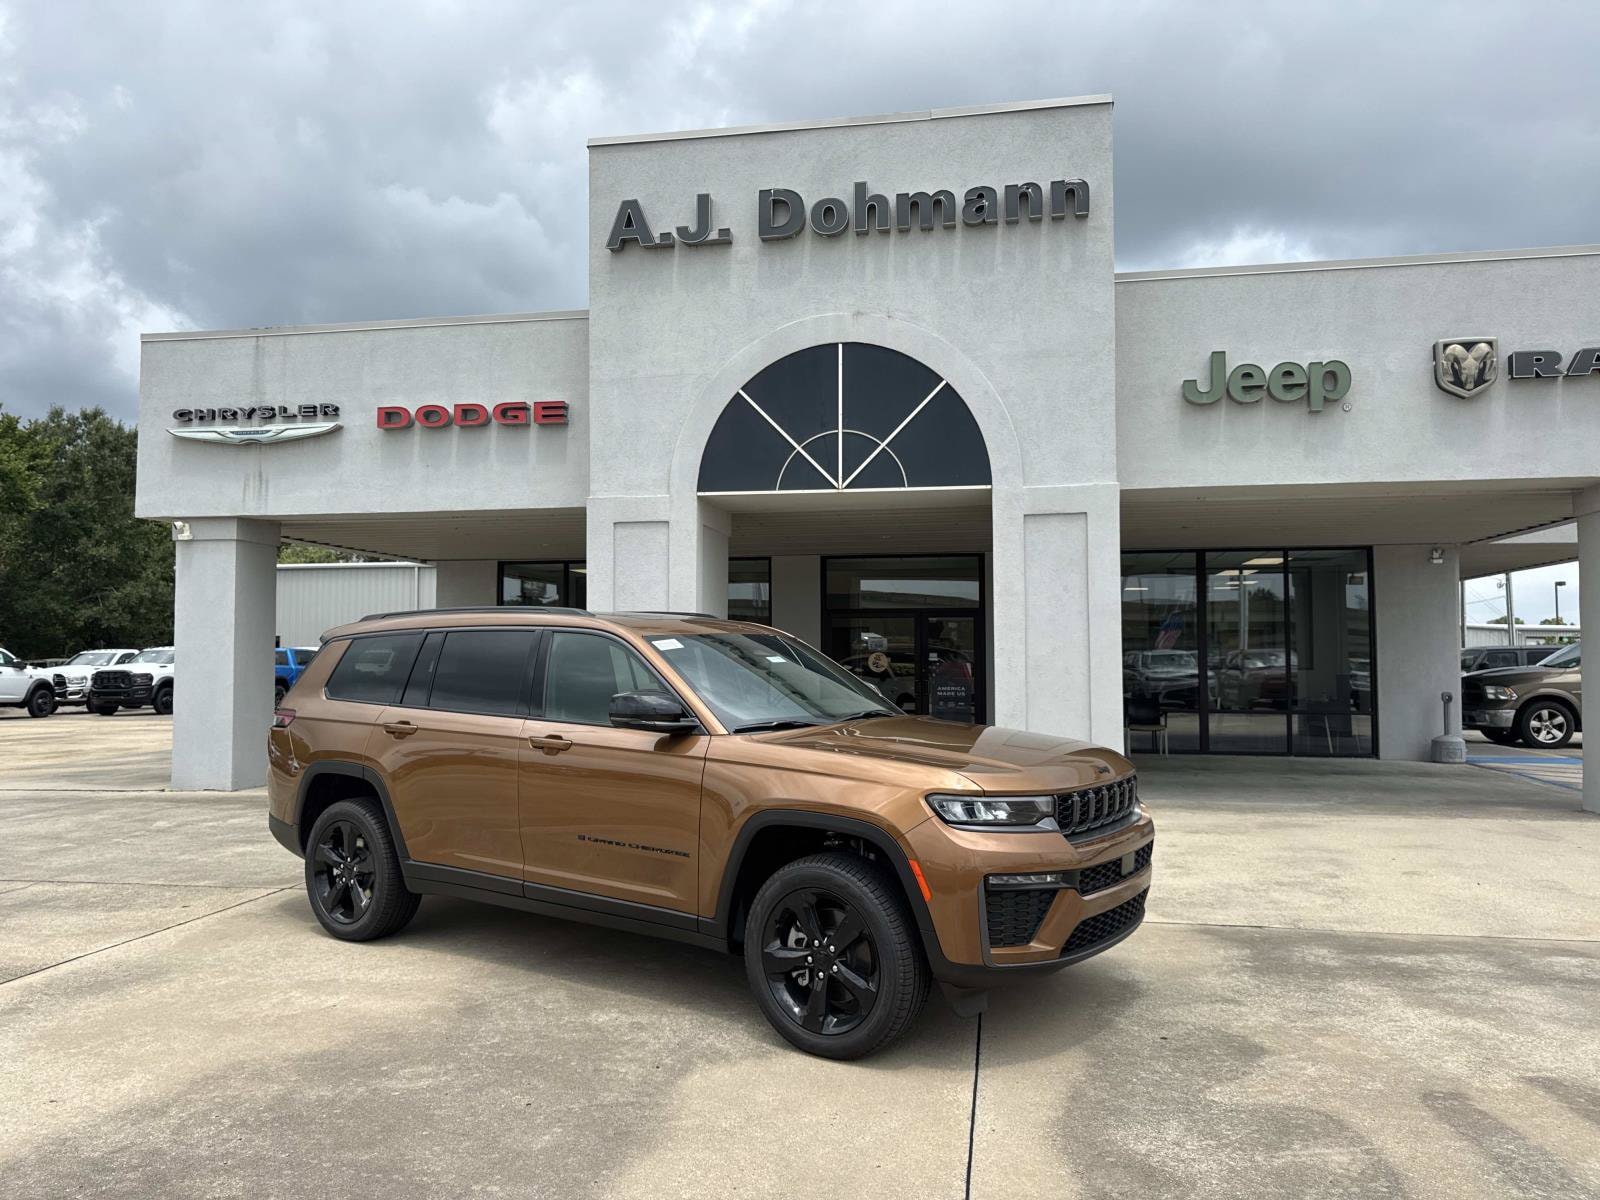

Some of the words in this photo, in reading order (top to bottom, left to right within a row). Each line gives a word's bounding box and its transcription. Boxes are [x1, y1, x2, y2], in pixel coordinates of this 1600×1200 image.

[605, 192, 733, 252] A.J.
[758, 177, 1091, 241] Dohmann
[1182, 350, 1352, 412] Jeep
[172, 402, 340, 422] CHRYSLER
[377, 400, 570, 429] DODGE
